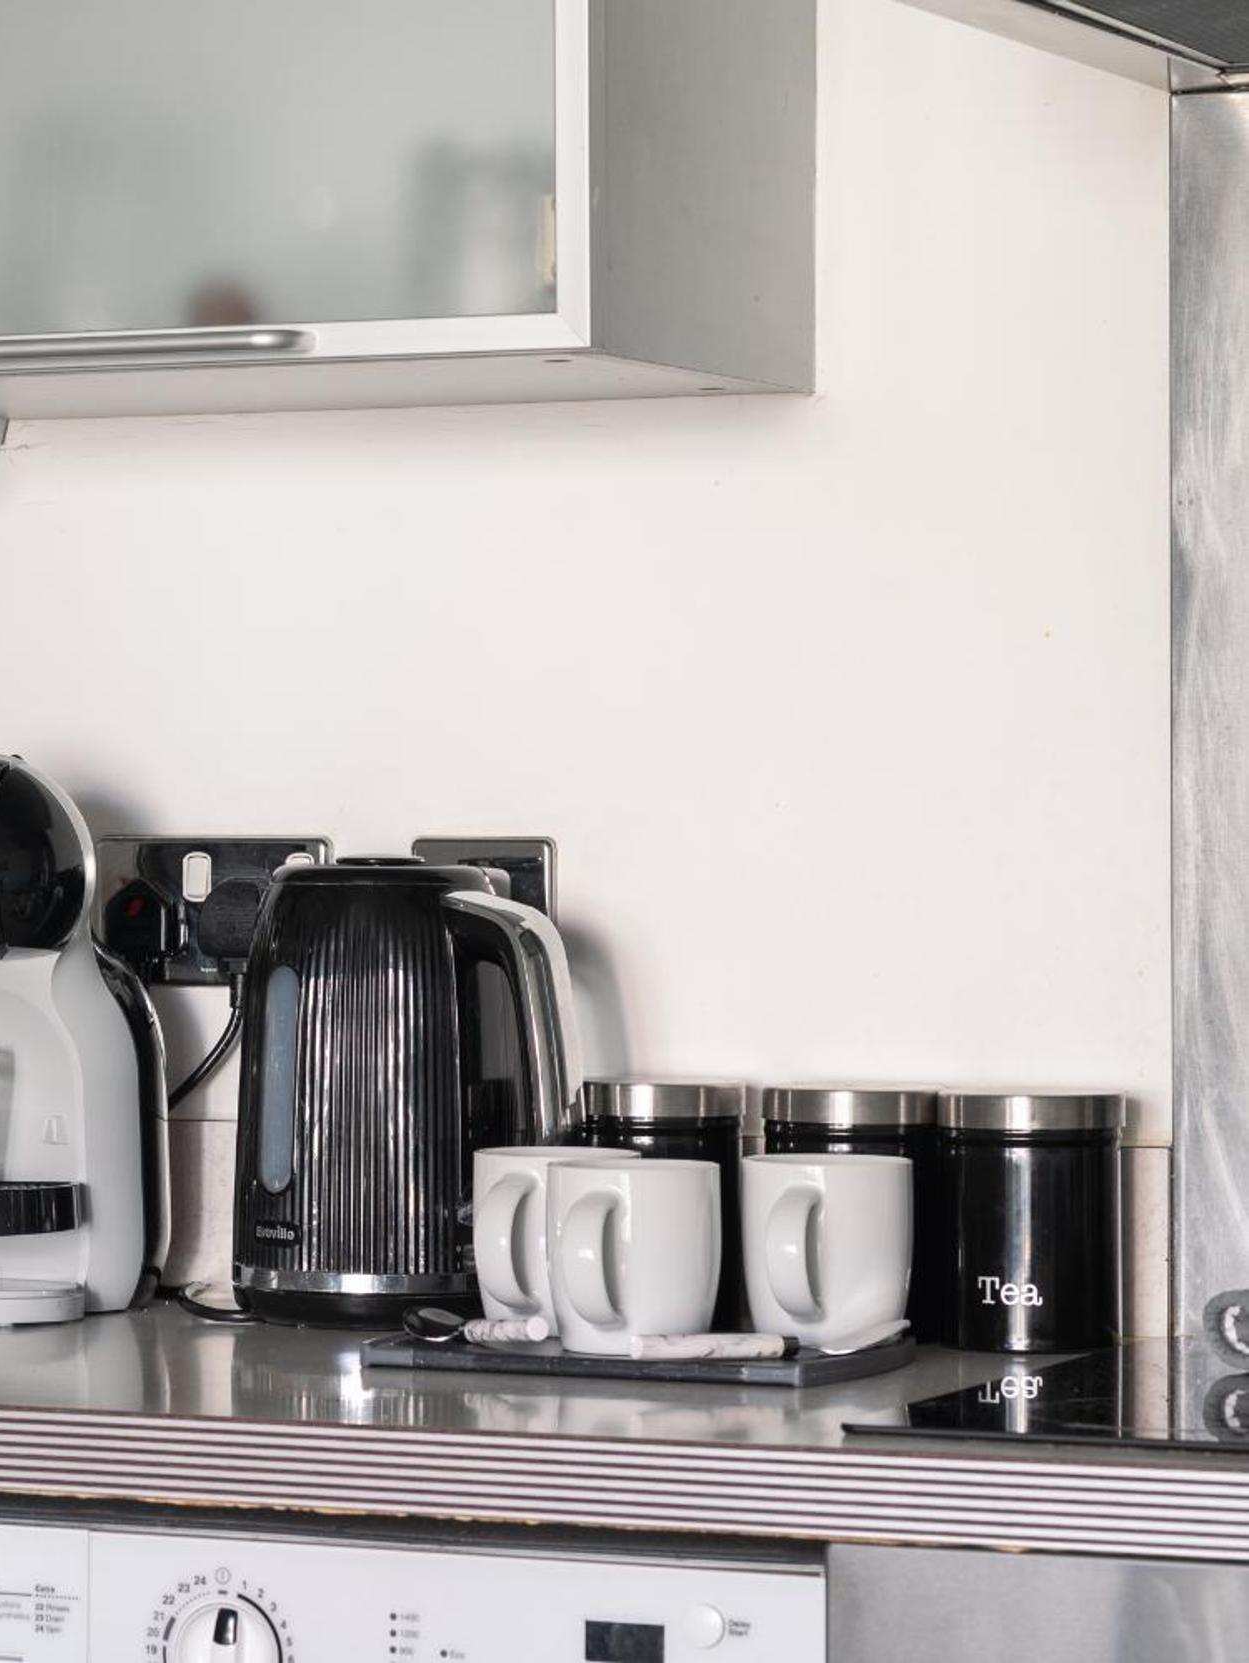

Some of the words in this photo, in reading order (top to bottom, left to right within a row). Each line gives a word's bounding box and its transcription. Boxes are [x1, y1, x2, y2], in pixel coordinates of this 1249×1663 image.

[977, 1276, 1043, 1306] Tea
[194, 1576, 206, 1585] 24
[178, 1583, 190, 1593] 23
[162, 1594, 175, 1605] 22
[153, 1611, 164, 1620] 21
